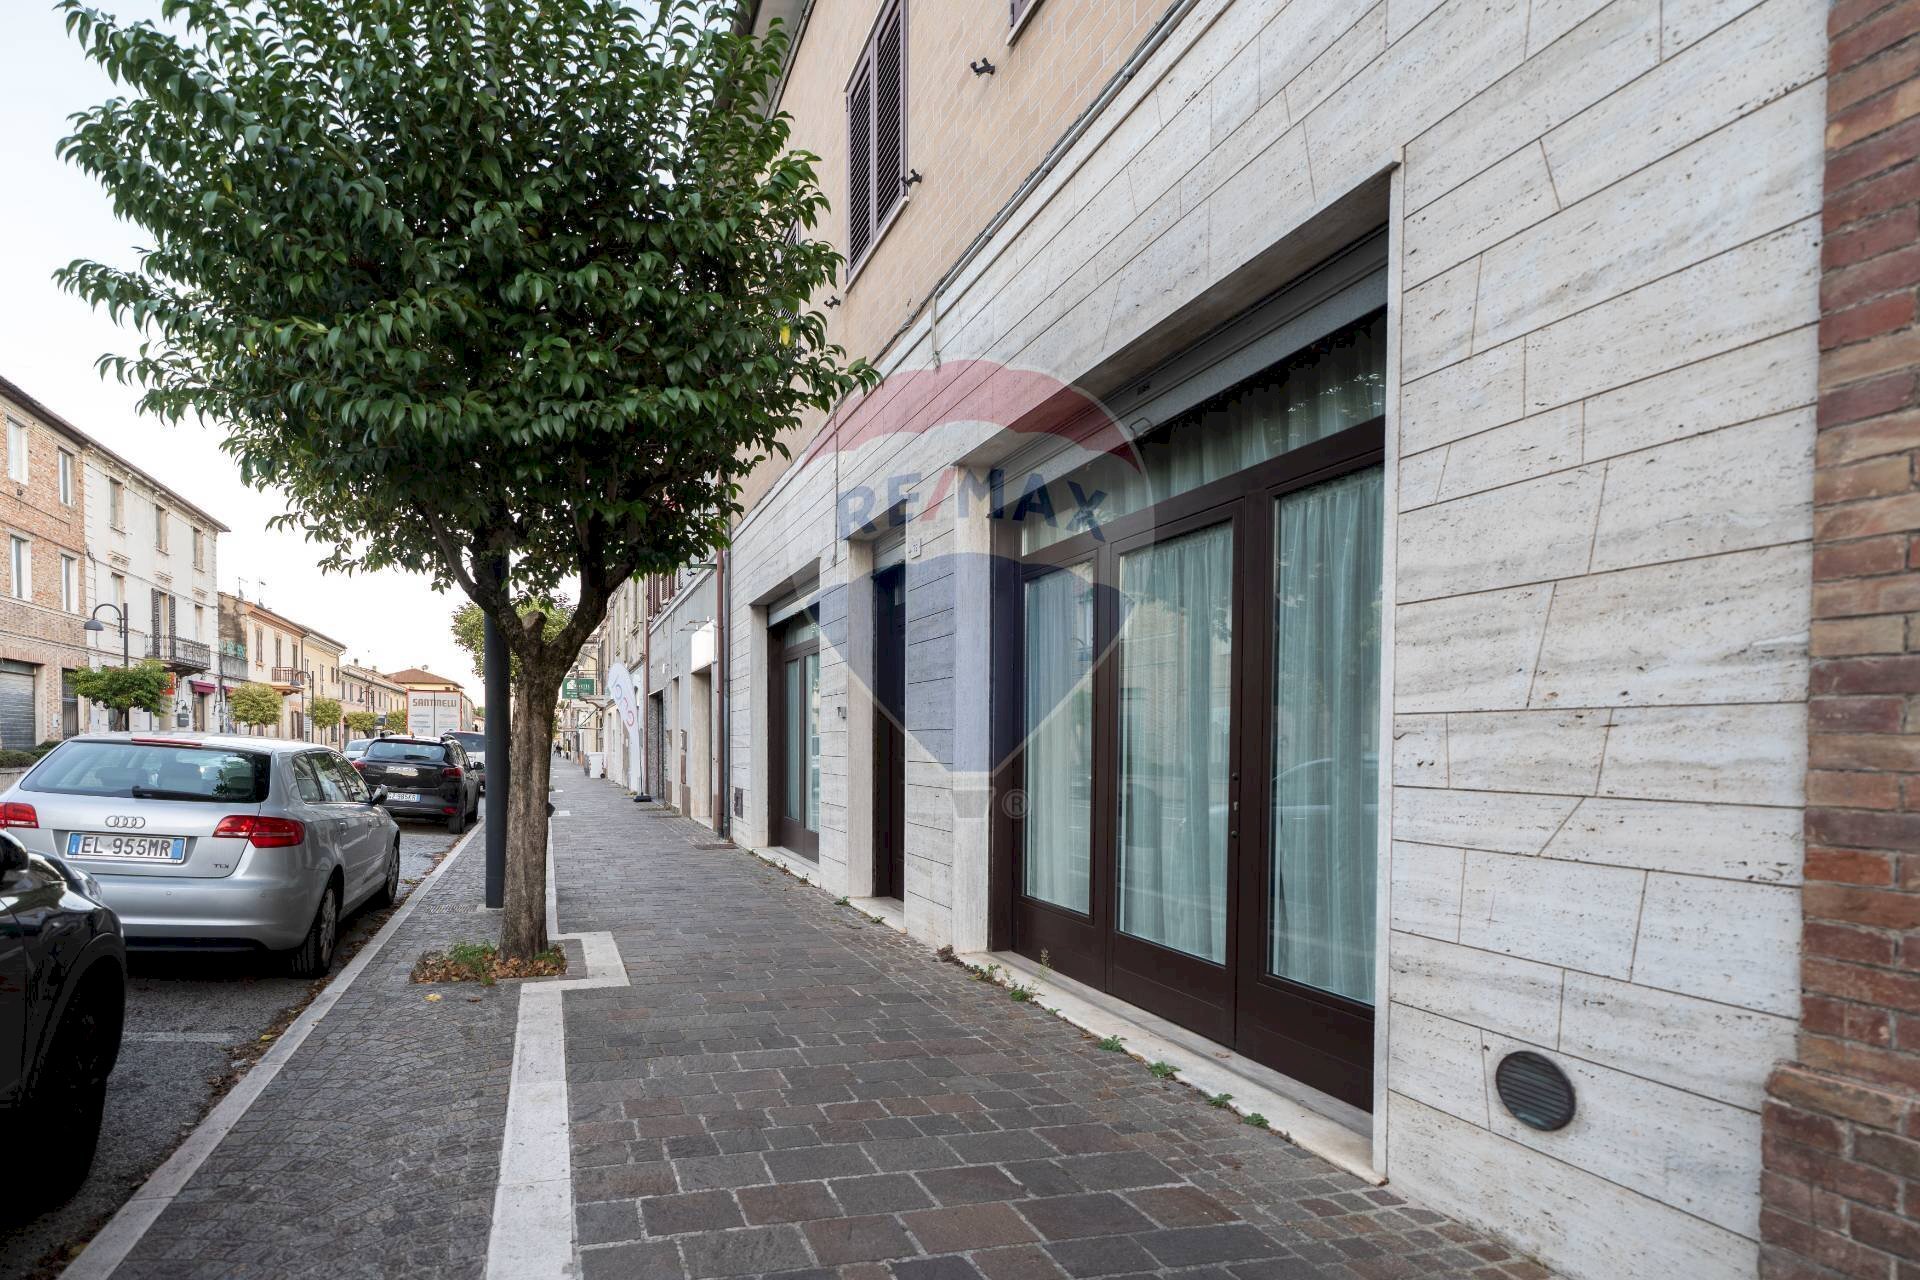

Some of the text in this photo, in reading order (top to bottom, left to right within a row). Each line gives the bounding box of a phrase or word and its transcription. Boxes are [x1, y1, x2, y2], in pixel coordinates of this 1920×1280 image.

[412, 698, 456, 708] SANTINELLI
[82, 836, 171, 857] EL 955MR
